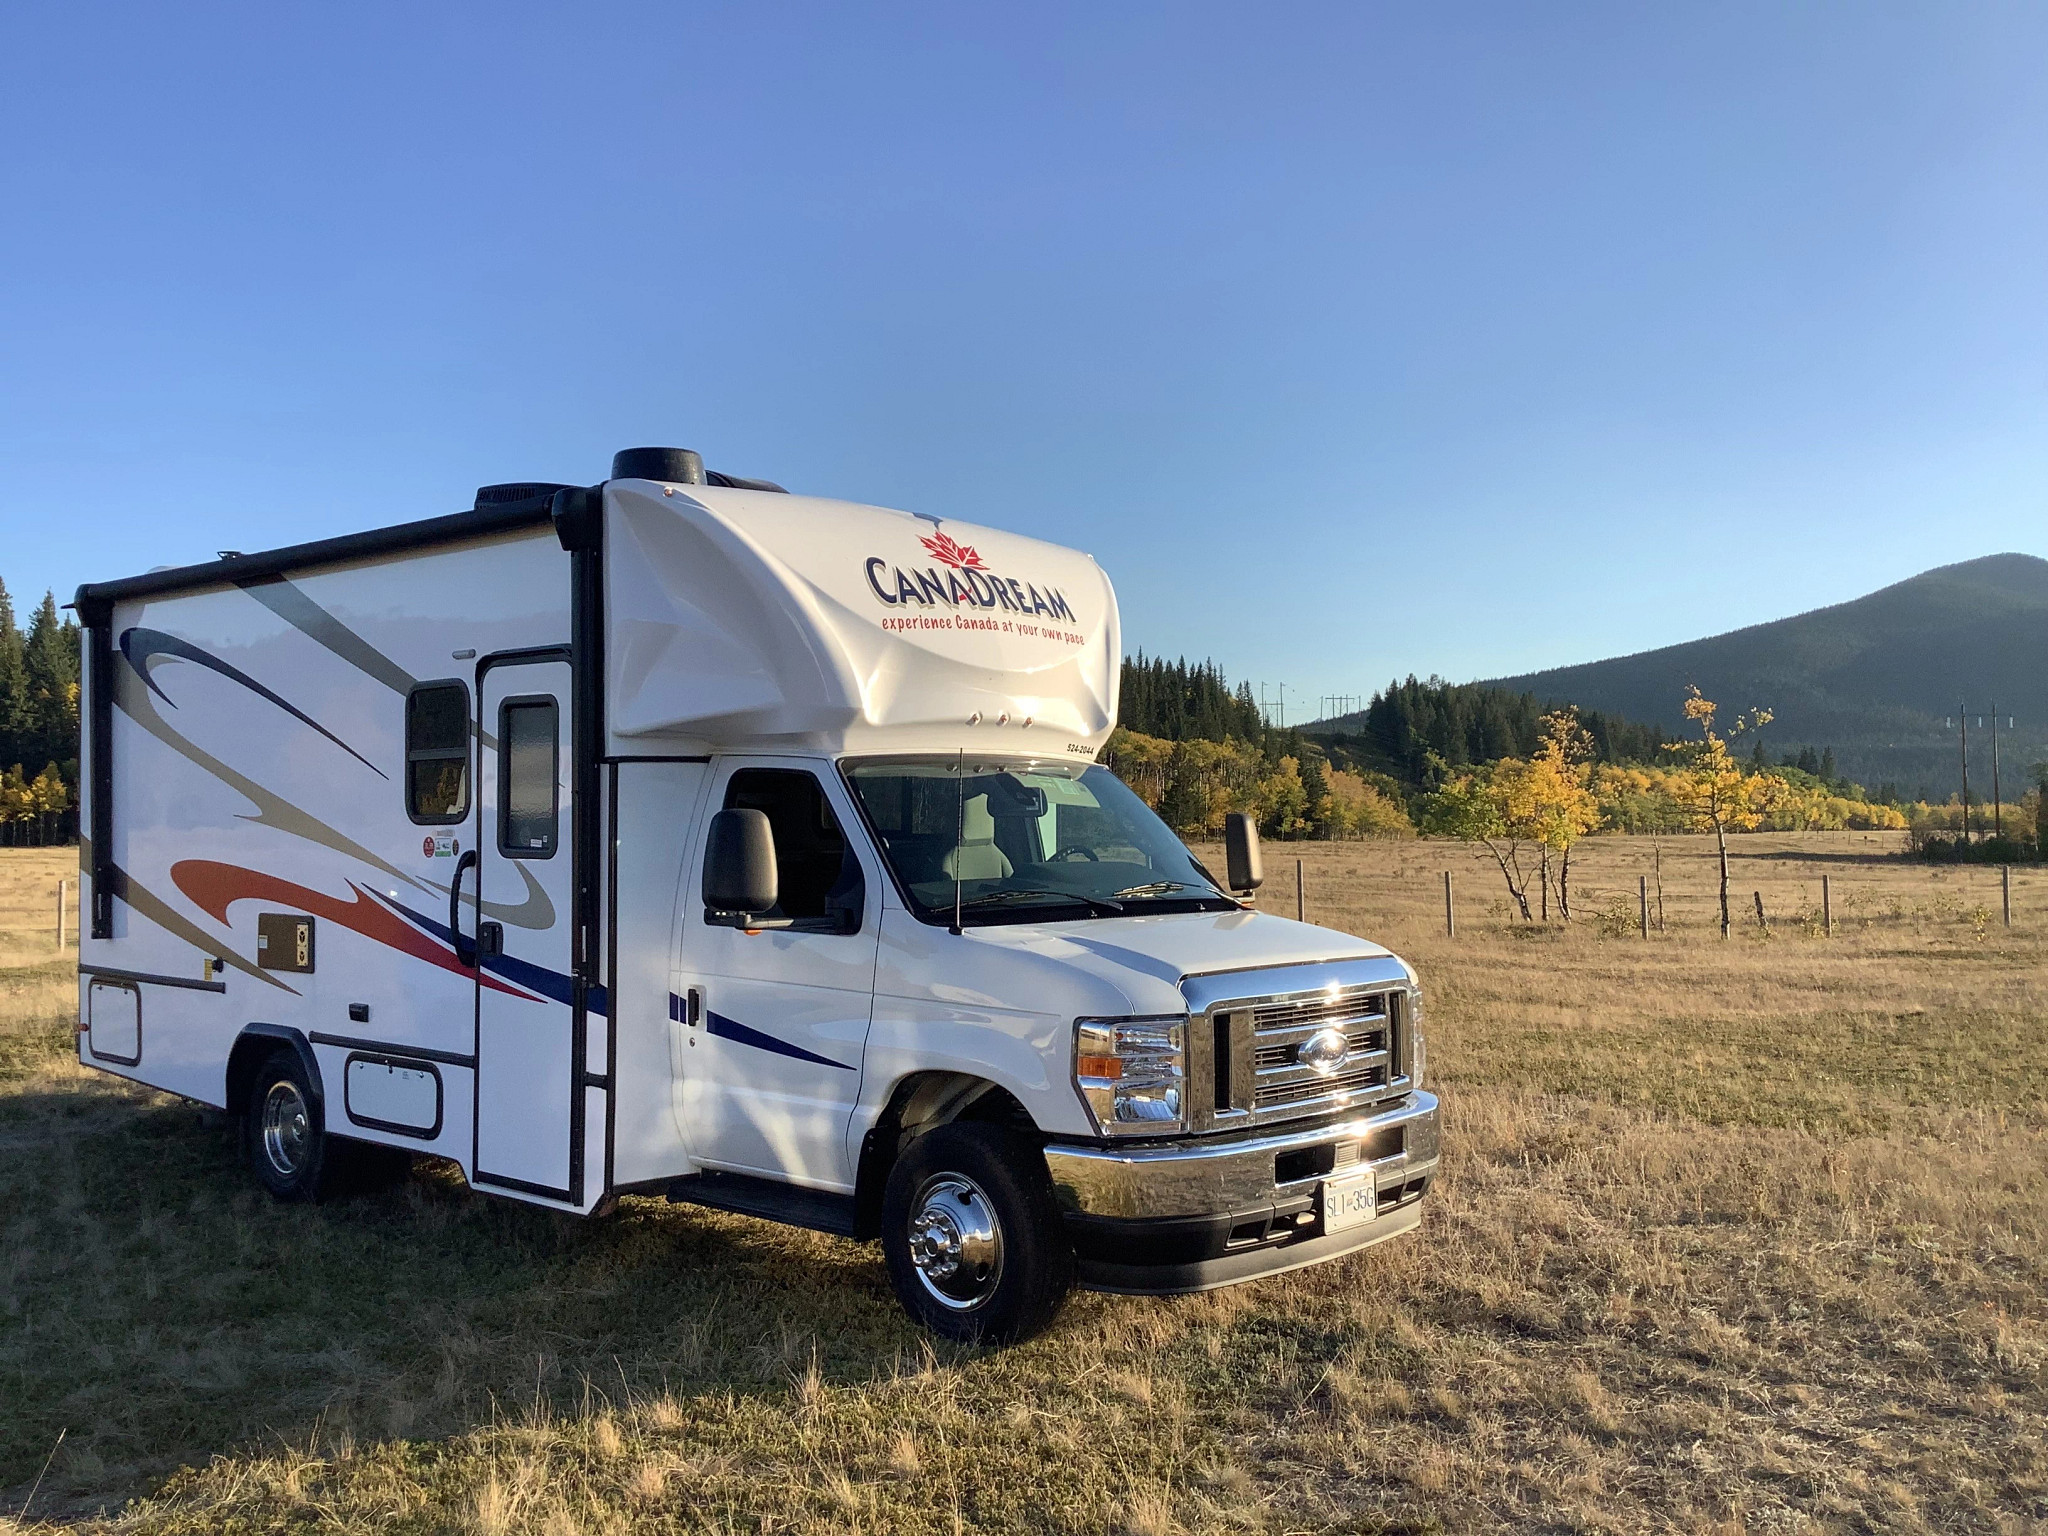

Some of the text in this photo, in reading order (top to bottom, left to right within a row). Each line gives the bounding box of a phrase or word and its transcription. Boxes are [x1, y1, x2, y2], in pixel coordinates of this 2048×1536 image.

[882, 614, 1085, 646] experience Canada at your own pace
[1066, 743, 1094, 755] 524-2044
